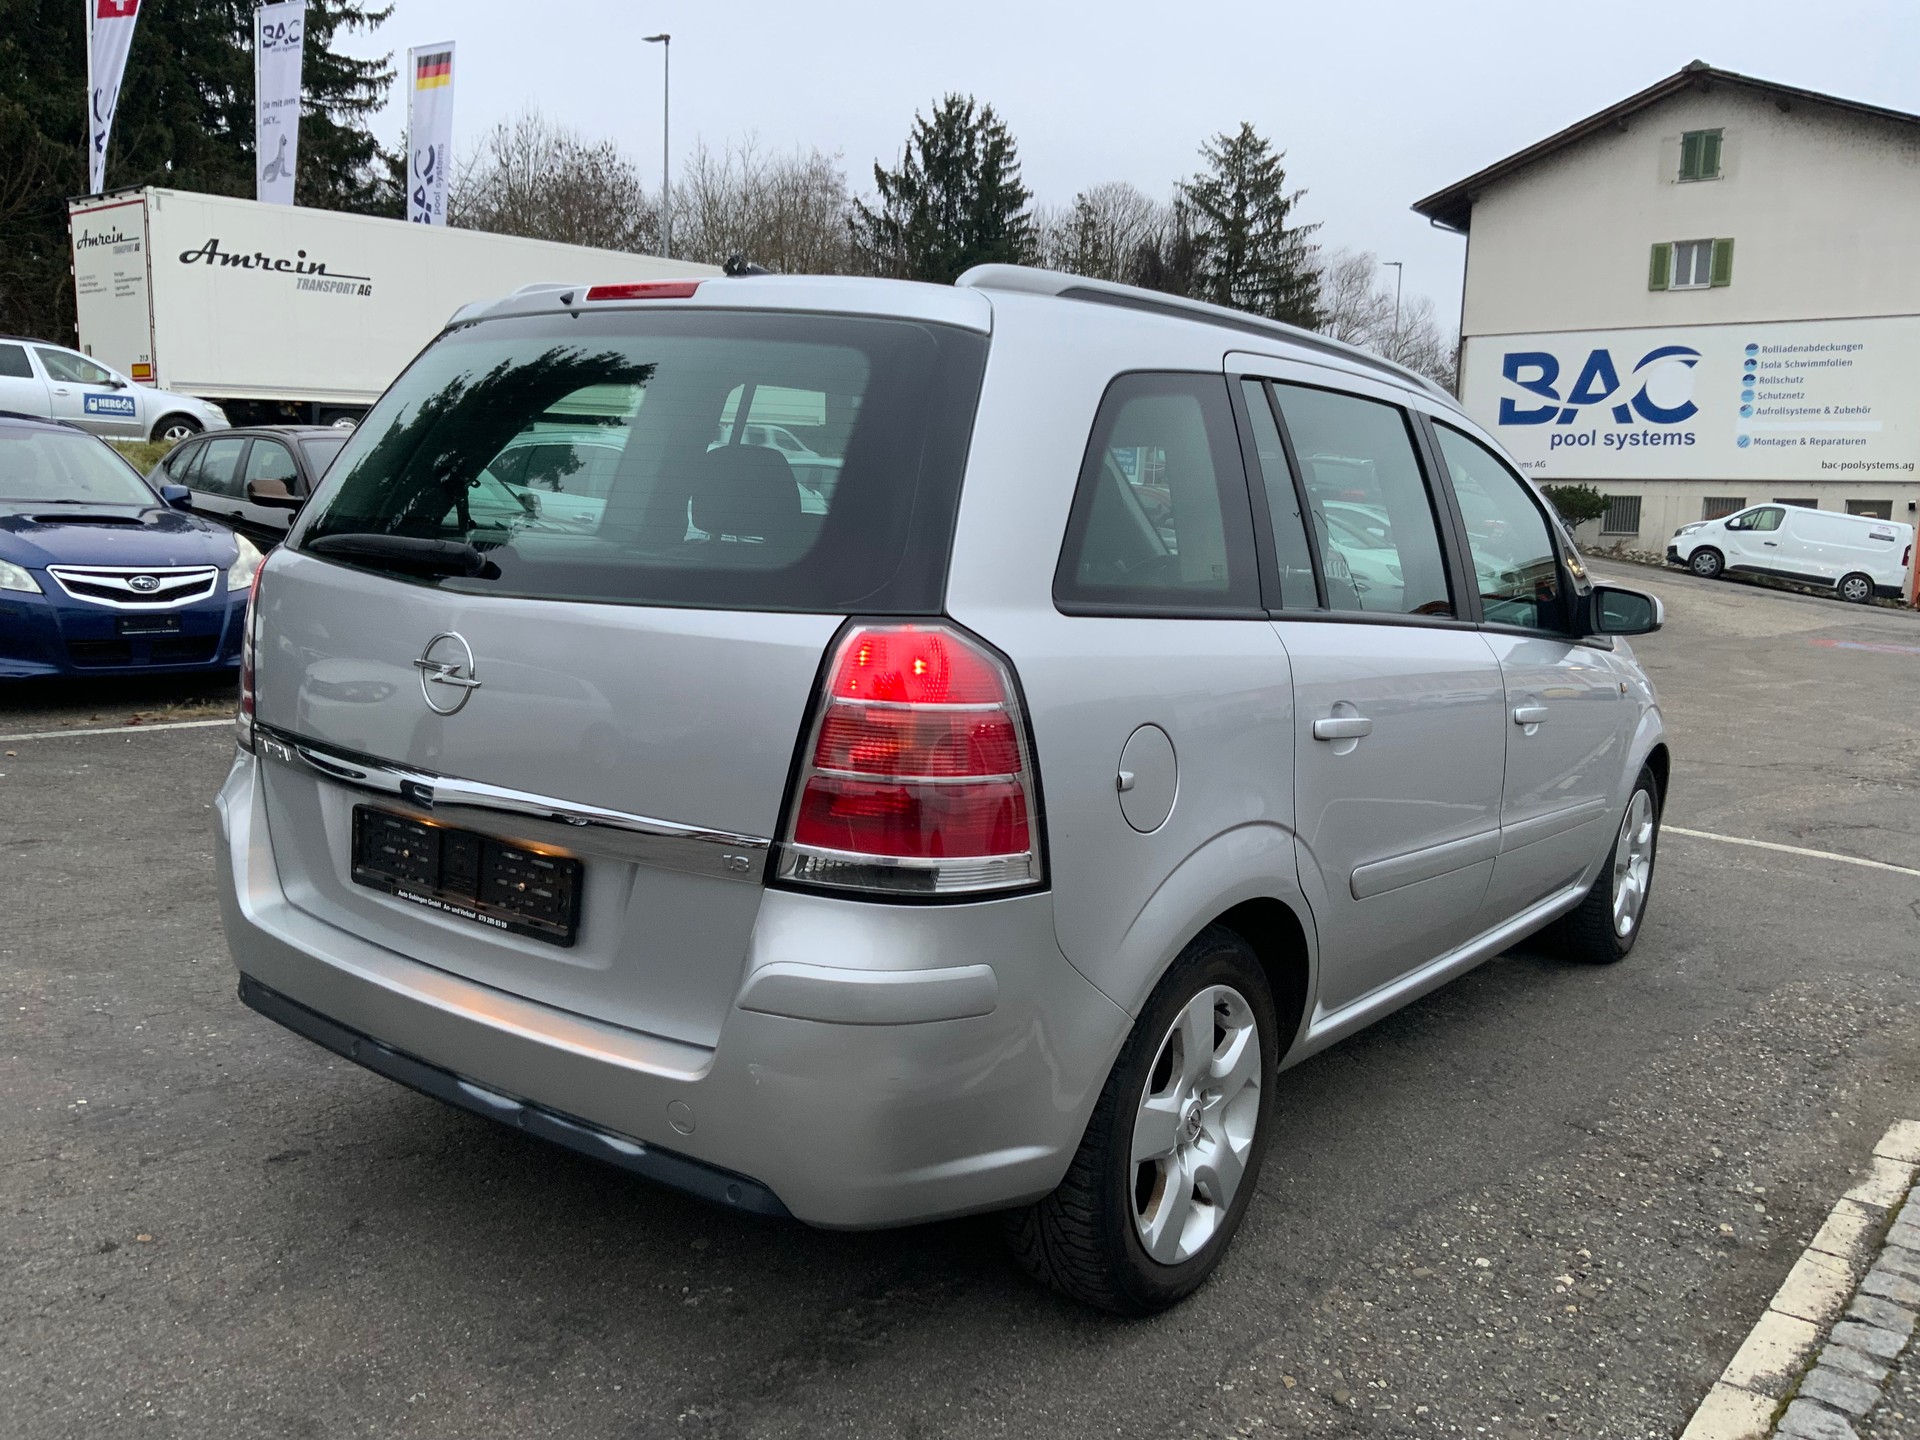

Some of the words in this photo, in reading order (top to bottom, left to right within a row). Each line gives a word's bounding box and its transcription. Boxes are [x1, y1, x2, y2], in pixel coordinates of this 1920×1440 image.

[262, 19, 301, 48] BAC
[271, 99, 282, 107] mit
[436, 143, 444, 188] systems
[434, 191, 442, 215] pool
[134, 242, 140, 252] AG
[179, 238, 371, 280] Amrein
[296, 277, 357, 295] TRANSPORT
[357, 284, 372, 296] AG
[1760, 360, 1782, 369] Isola
[1784, 358, 1853, 368] Schwimmfolien
[1498, 345, 1703, 426] BAC
[1758, 375, 1804, 385] Rollschutz
[1757, 391, 1805, 400] Schutznetz
[1756, 405, 1822, 417] Aufrollsysteme
[1823, 405, 1831, 414] &
[1833, 405, 1872, 414] Zubehör
[1550, 429, 1597, 450] pool
[1603, 430, 1696, 450] systems
[1753, 437, 1797, 448] Montagen
[1799, 437, 1807, 446] &
[1809, 437, 1867, 447] Reparaturen
[1534, 460, 1546, 469] AG
[1821, 460, 1915, 472] bac-poolsystems.ag
